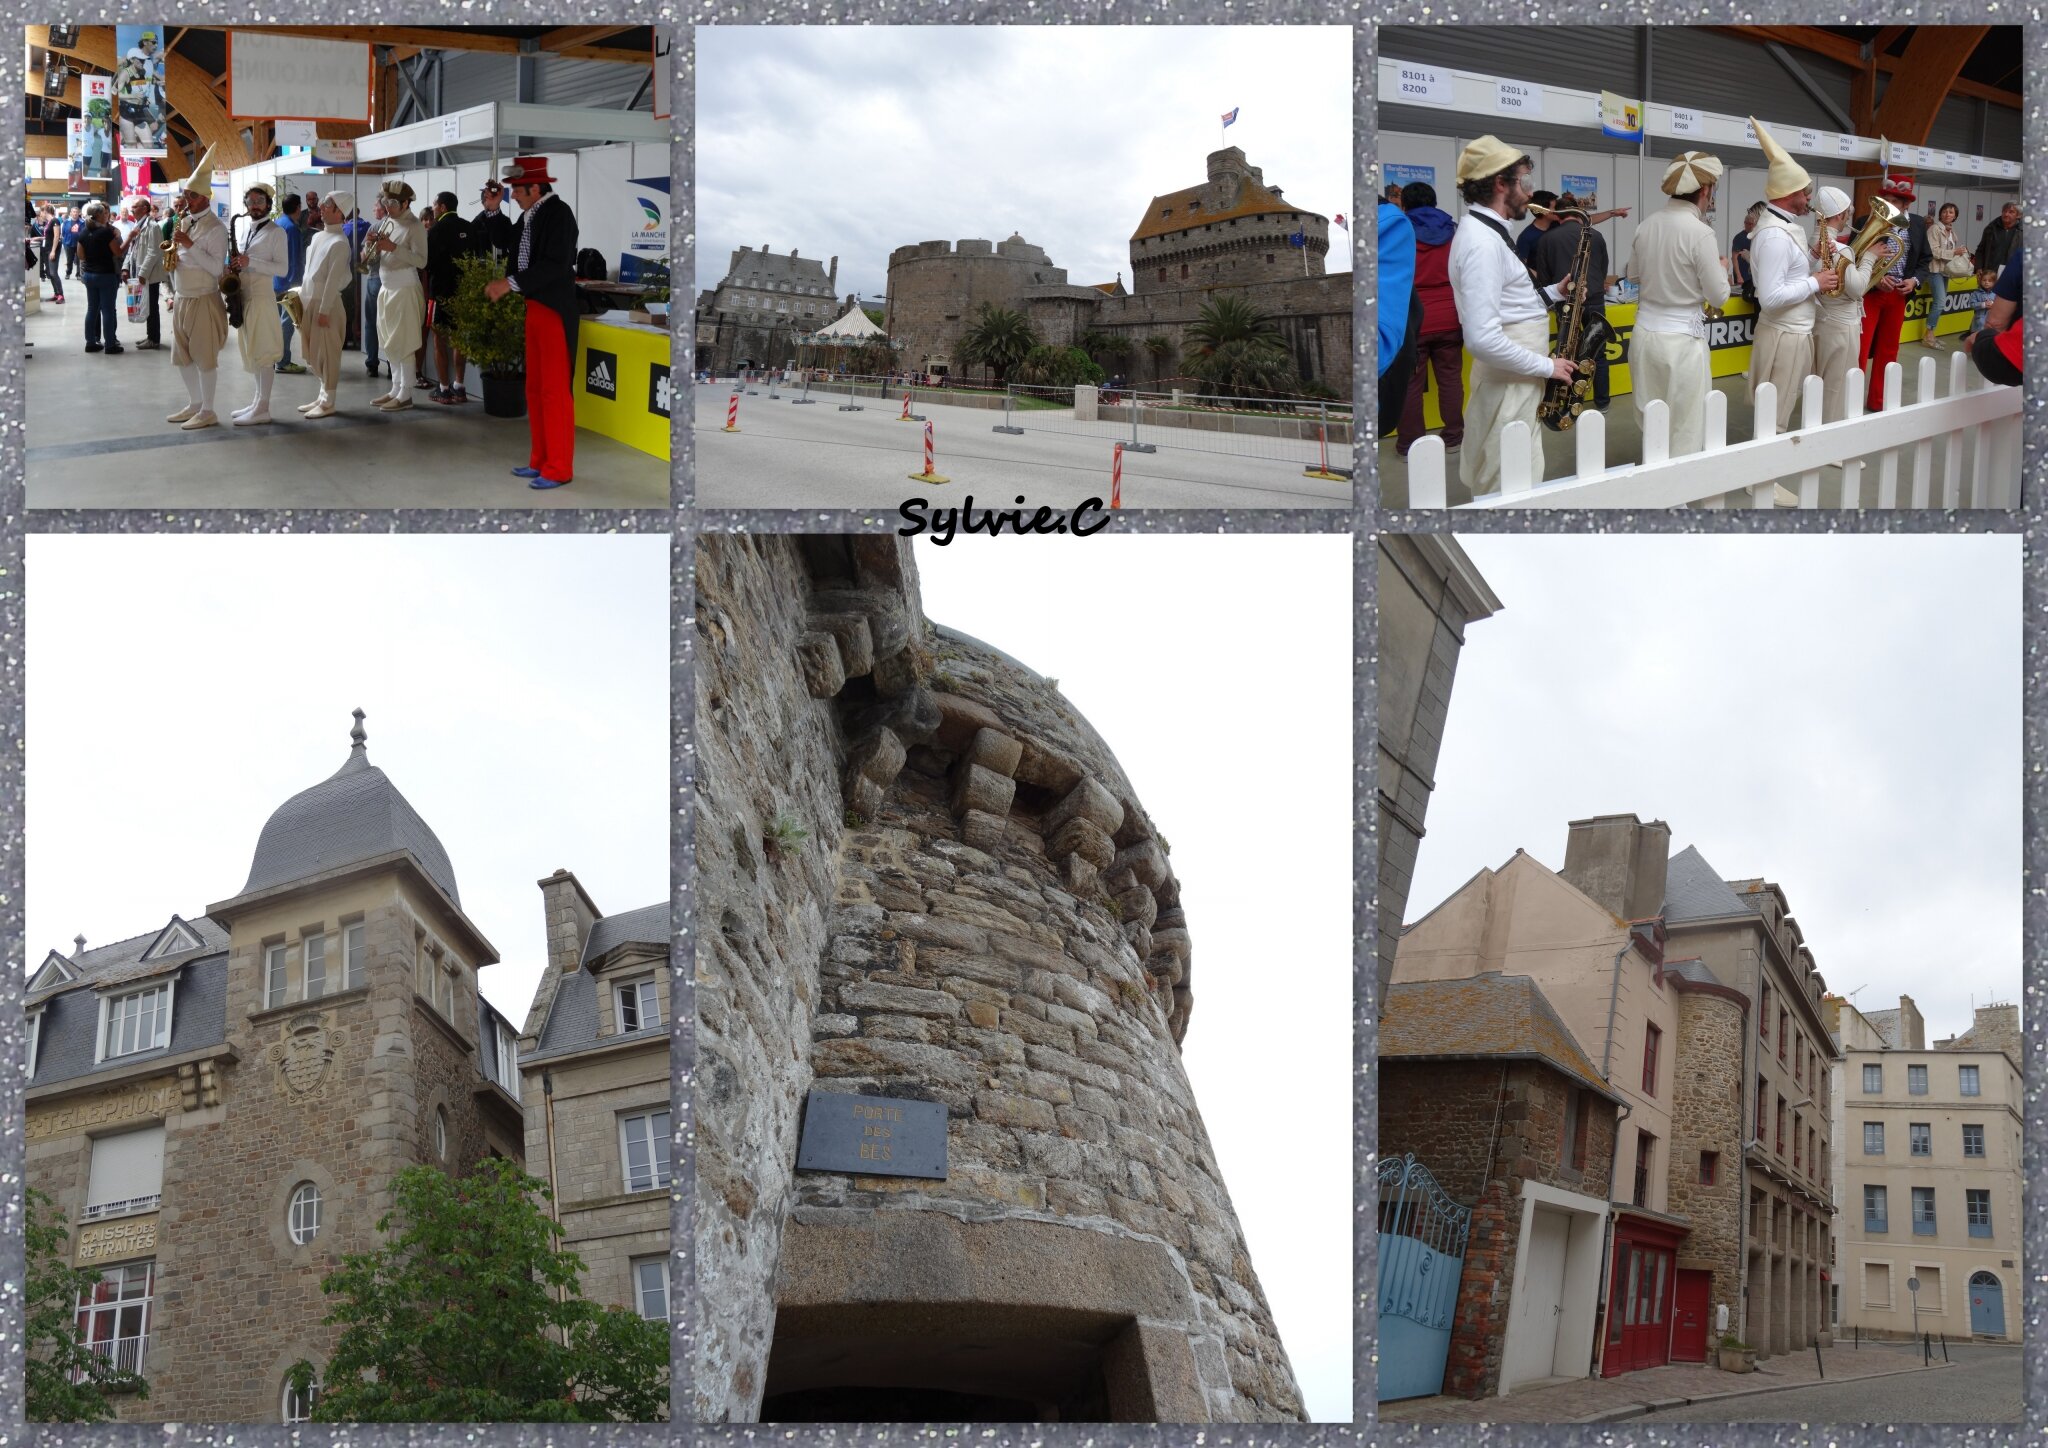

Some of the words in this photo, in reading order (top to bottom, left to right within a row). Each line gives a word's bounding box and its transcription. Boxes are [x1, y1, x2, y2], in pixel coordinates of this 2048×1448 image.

[1402, 70, 1426, 82] 8101
[1429, 74, 1435, 83] à
[1402, 83, 1427, 94] 8200
[1501, 85, 1520, 95] 8201
[1501, 97, 1521, 107] 8300
[588, 376, 615, 392] adidas
[854, 1105, 905, 1122] PORTE
[864, 1125, 891, 1137] DES
[81, 1224, 135, 1244] CAISSE
[137, 1223, 157, 1235] DES
[80, 1235, 156, 1259] RETRAITES
